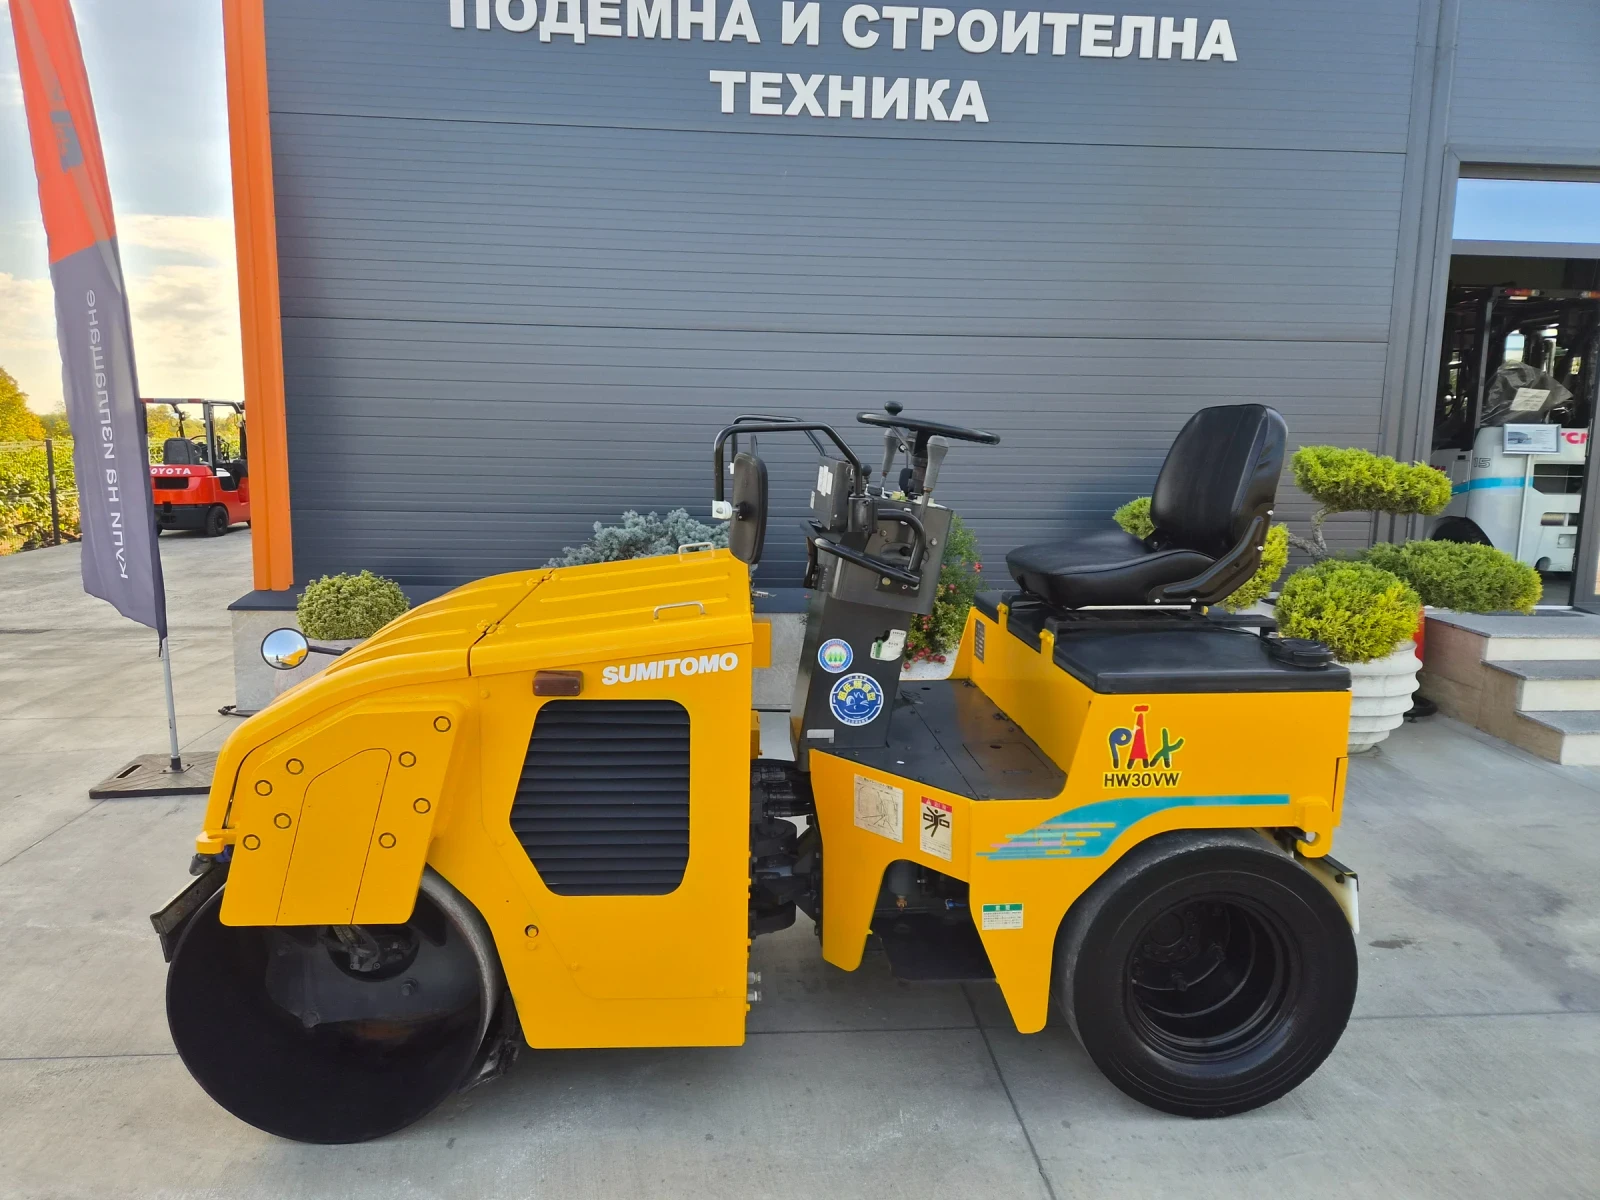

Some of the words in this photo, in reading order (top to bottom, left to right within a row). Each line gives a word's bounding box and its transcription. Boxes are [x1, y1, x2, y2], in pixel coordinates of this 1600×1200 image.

[450, 0, 761, 43] ПОДЕМНА
[781, 1, 820, 45] И
[842, 4, 1238, 62] СТРОИТЕЛНА
[709, 70, 989, 123] ТЕХНИКА
[150, 467, 191, 475] OYOTA
[1473, 457, 1491, 468] 15
[601, 652, 739, 686] SUMITOMO
[1103, 771, 1181, 788] HW30VW
